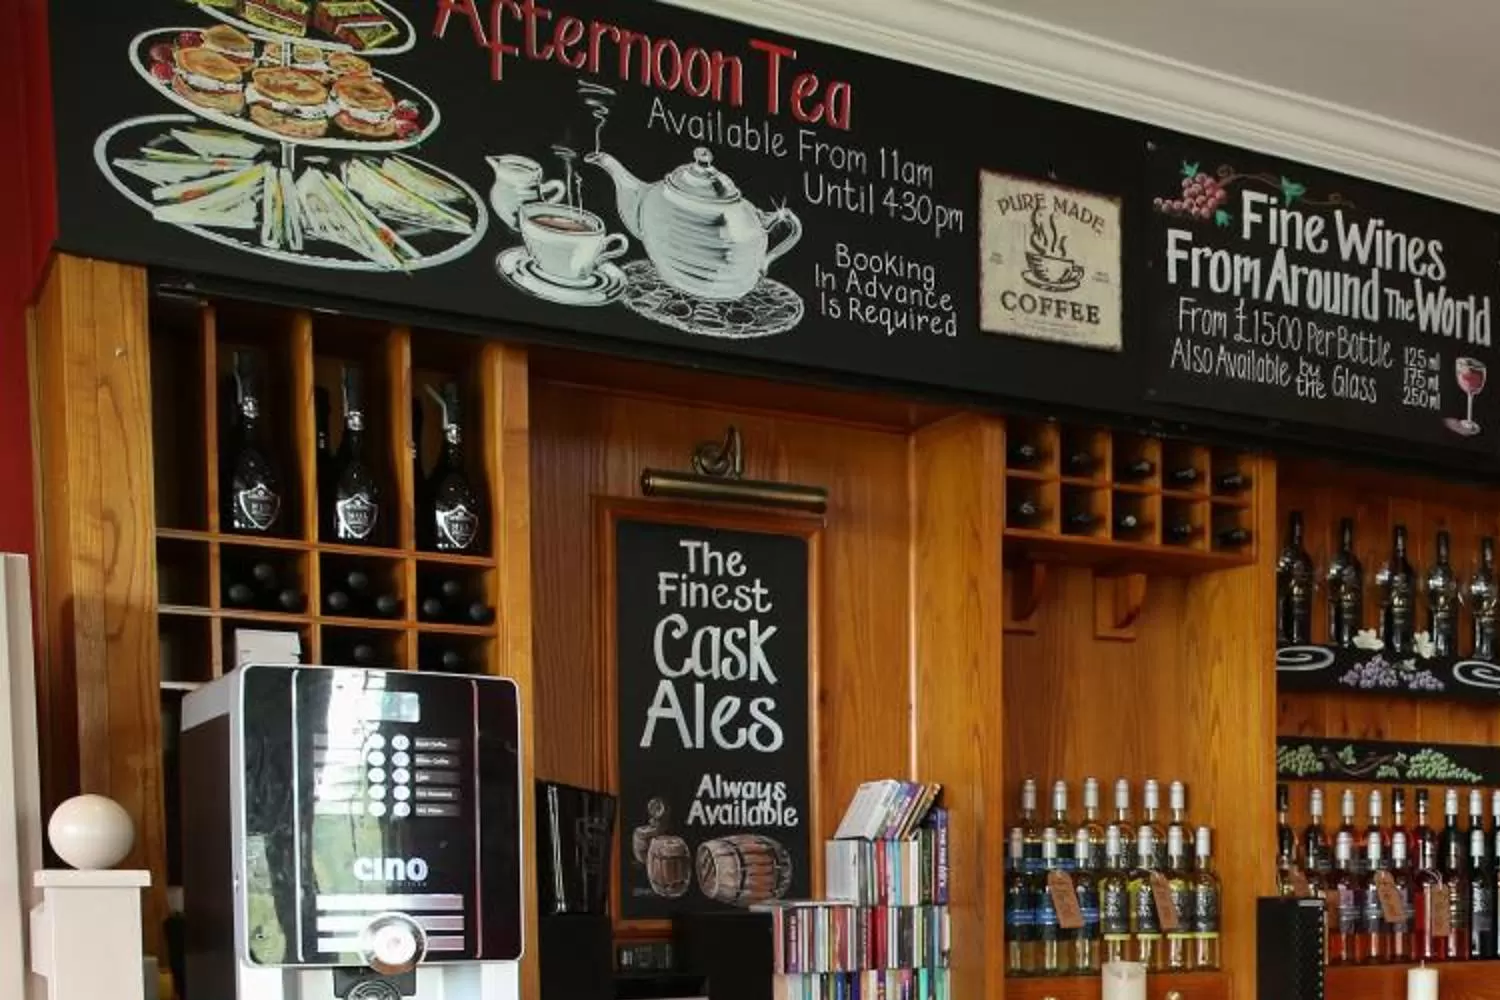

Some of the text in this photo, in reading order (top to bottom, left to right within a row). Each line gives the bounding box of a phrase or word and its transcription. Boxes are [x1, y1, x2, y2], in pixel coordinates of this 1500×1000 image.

[432, 0, 852, 131] Afternoon Tea
[647, 95, 934, 191] Available From 11am
[803, 171, 875, 217] Until
[997, 192, 1106, 235] PURE MADE
[1241, 188, 1448, 282] Fine Wines
[815, 262, 954, 312] In Advance
[835, 242, 936, 292] Booking
[1166, 228, 1493, 348] From Around The World
[820, 290, 958, 337] Is Required
[1000, 289, 1101, 325] COFFEE
[1178, 295, 1228, 338] From
[1306, 321, 1336, 357] Per
[1336, 324, 1394, 370] Bottle
[1170, 336, 1214, 374] Also
[1215, 343, 1291, 387] Available
[1299, 355, 1322, 385] by
[1331, 363, 1378, 404] Glass
[1403, 346, 1427, 369] 125
[1403, 367, 1427, 389] 175
[1402, 386, 1429, 409] 250
[679, 539, 747, 578] The
[657, 571, 773, 614] Finest
[652, 612, 779, 685] Cask
[639, 679, 785, 753] Ales
[687, 798, 800, 828] Available
[695, 773, 787, 812] Always
[352, 857, 429, 882] cino
